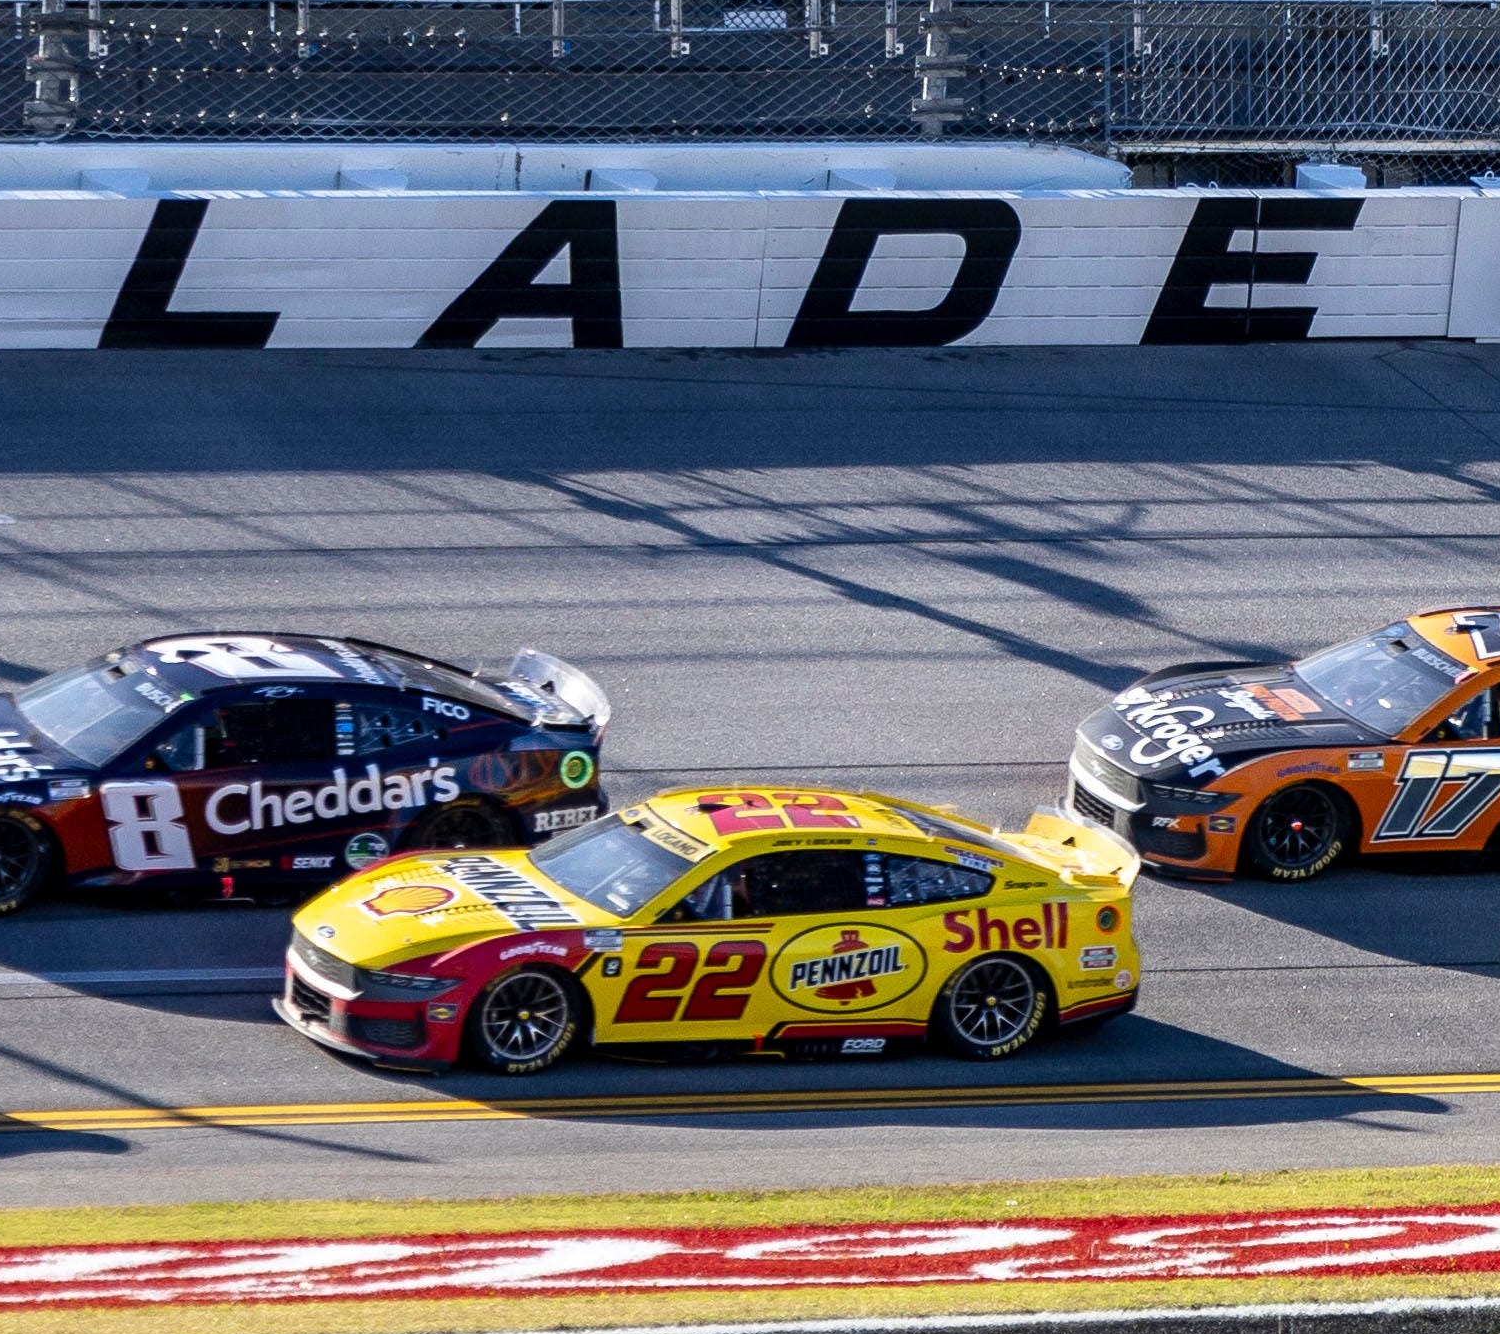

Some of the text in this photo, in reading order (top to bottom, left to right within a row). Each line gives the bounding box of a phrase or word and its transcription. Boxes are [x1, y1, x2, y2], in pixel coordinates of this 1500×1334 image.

[422, 696, 471, 721] FICO
[204, 757, 461, 836] Cheddar's
[696, 792, 862, 837] 22
[101, 779, 197, 871] 8
[650, 828, 699, 857] LOGANO
[293, 855, 336, 870] SENIX
[942, 901, 1069, 954] Shell
[499, 940, 570, 962] GOODYEAR
[788, 945, 907, 992] PENNZOIL
[611, 938, 768, 1025] 22
[841, 1038, 887, 1050] FORD
